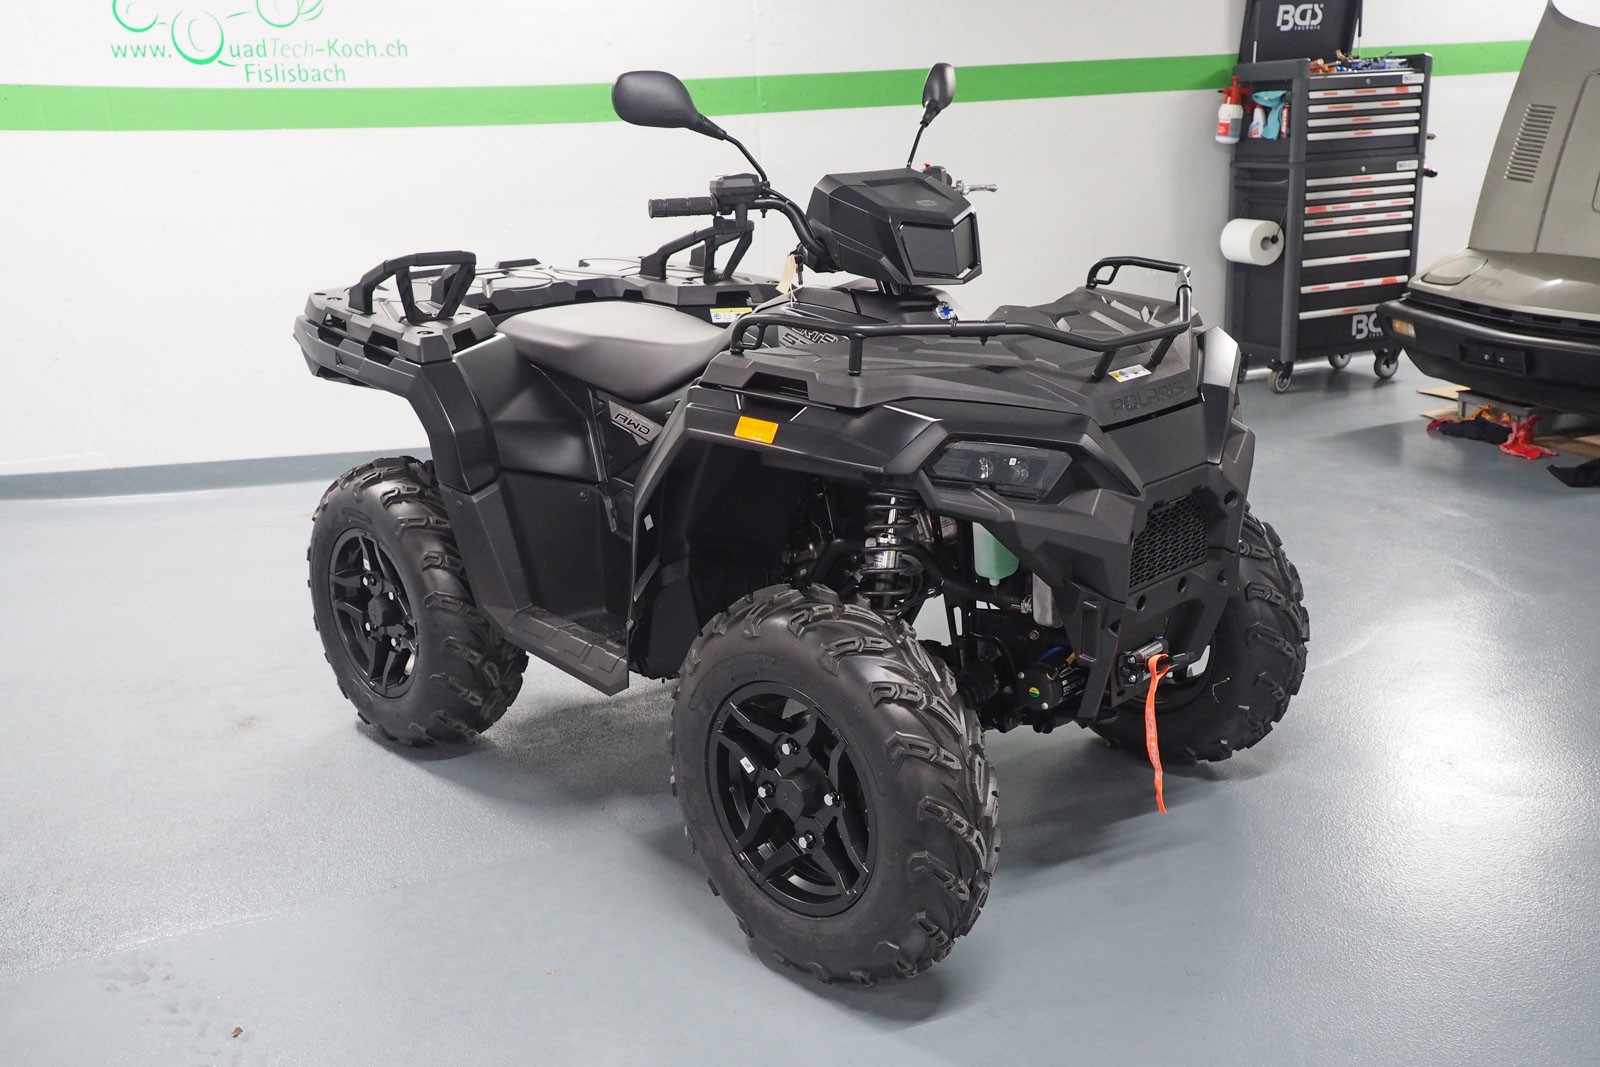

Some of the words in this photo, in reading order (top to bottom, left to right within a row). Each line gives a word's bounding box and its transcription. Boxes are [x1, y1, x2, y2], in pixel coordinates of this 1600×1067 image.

[1276, 3, 1323, 31] BGS
[244, 63, 346, 83] Fislisbach
[613, 412, 651, 435] AWD
